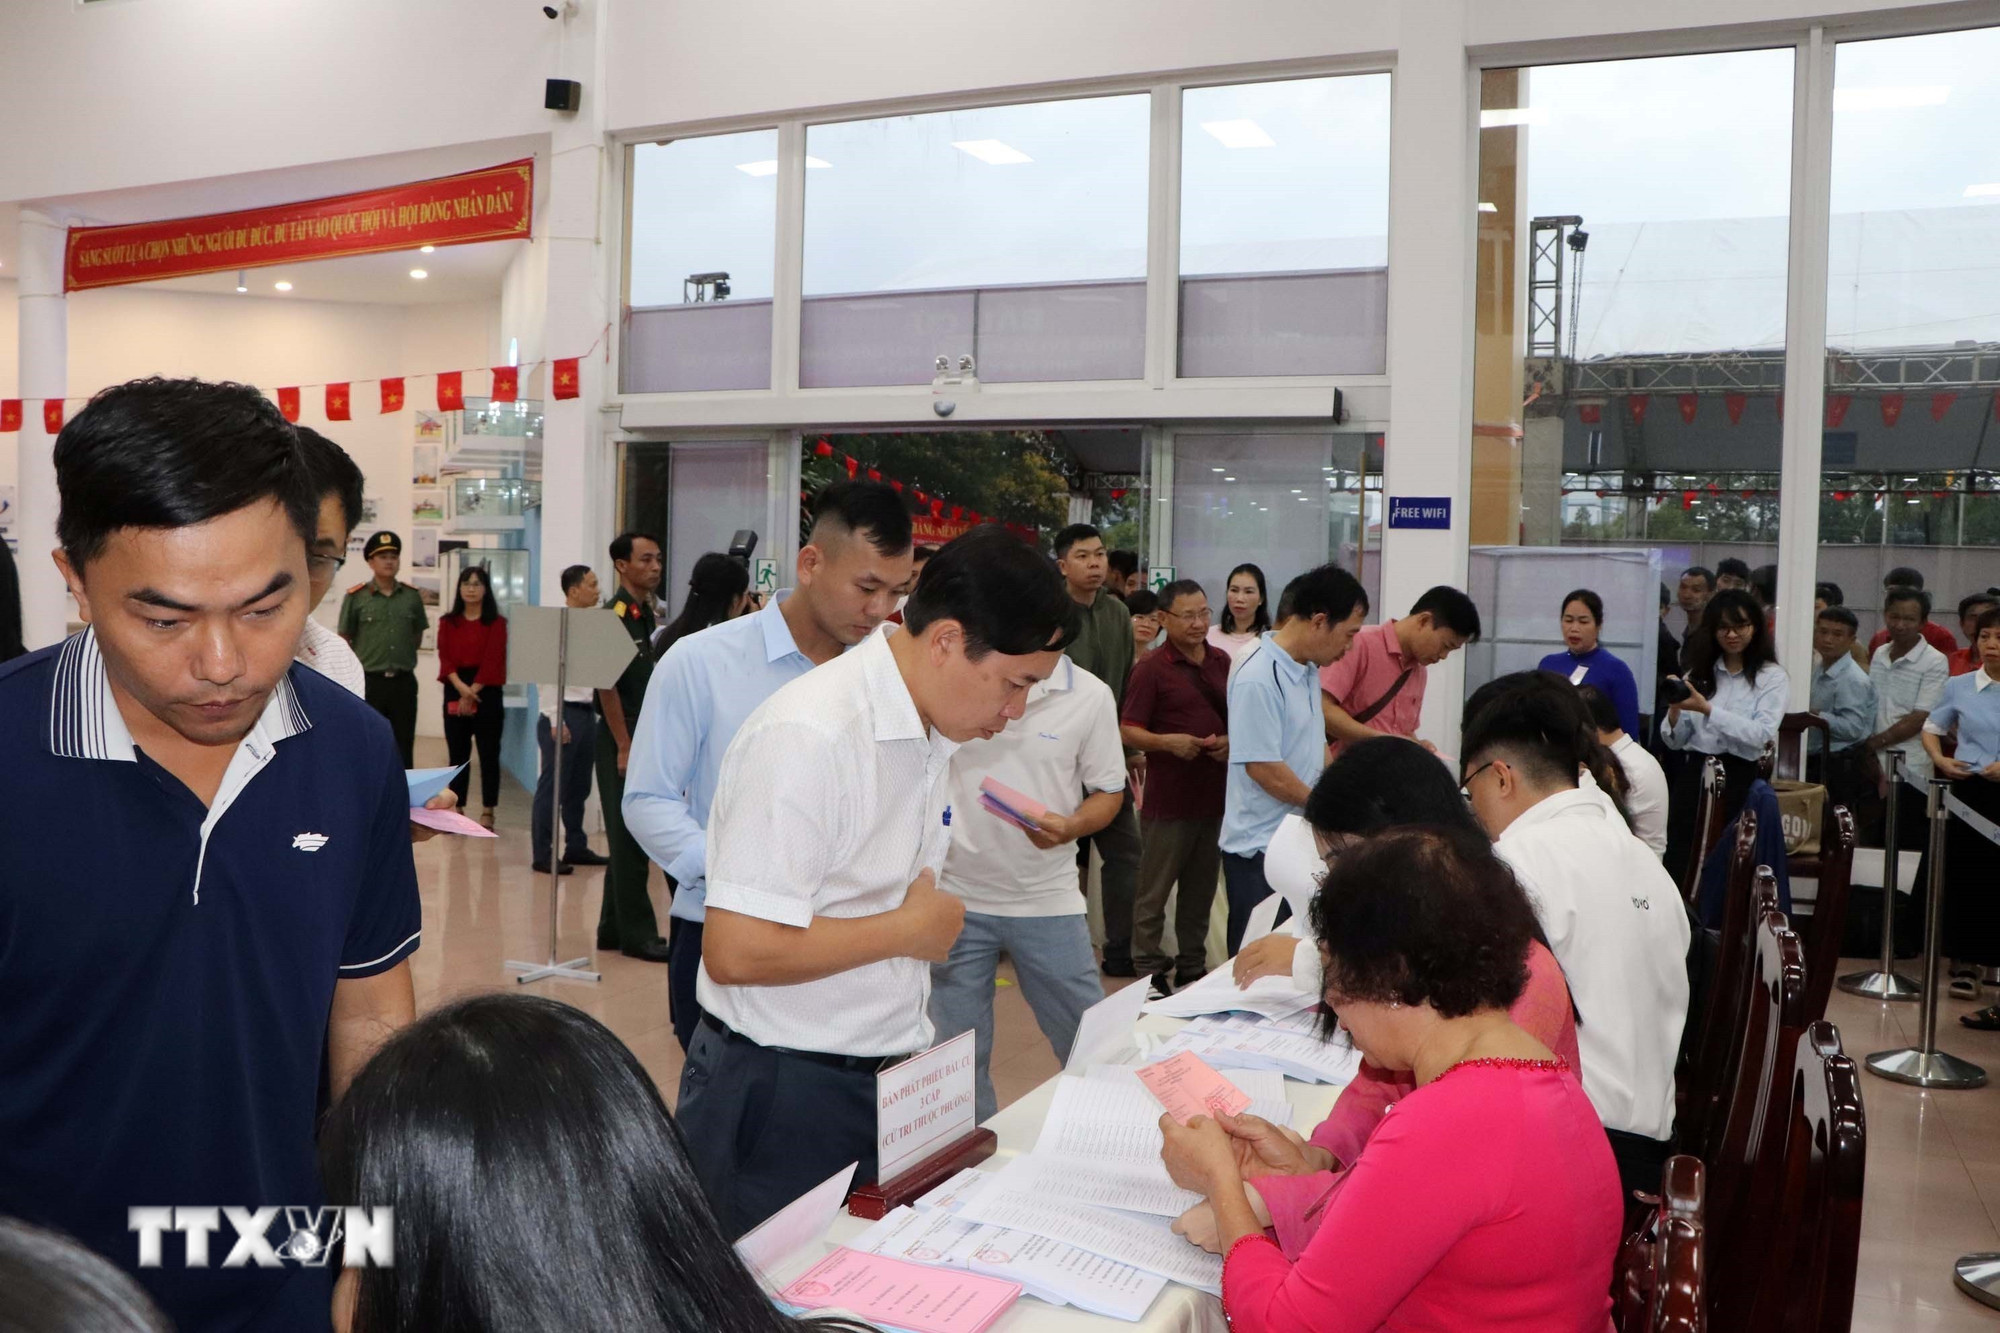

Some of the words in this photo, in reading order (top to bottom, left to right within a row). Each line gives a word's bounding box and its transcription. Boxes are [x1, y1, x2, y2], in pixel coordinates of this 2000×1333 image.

[145, 239, 169, 264] CHỌN
[172, 232, 203, 257] NHỮNG
[330, 208, 359, 241] QUỐC
[360, 207, 380, 237] HỘI
[382, 201, 397, 229] VÀ
[398, 202, 418, 232] HỘI
[420, 195, 452, 223] ĐỒNG
[453, 188, 485, 218] NHÂN
[486, 185, 514, 215] DÂN!
[1394, 507, 1420, 519] FREE
[1421, 507, 1447, 519] WIFI
[882, 1091, 899, 1109] BÀN
[920, 1096, 925, 1110] 3
[899, 1121, 912, 1139] TRI
